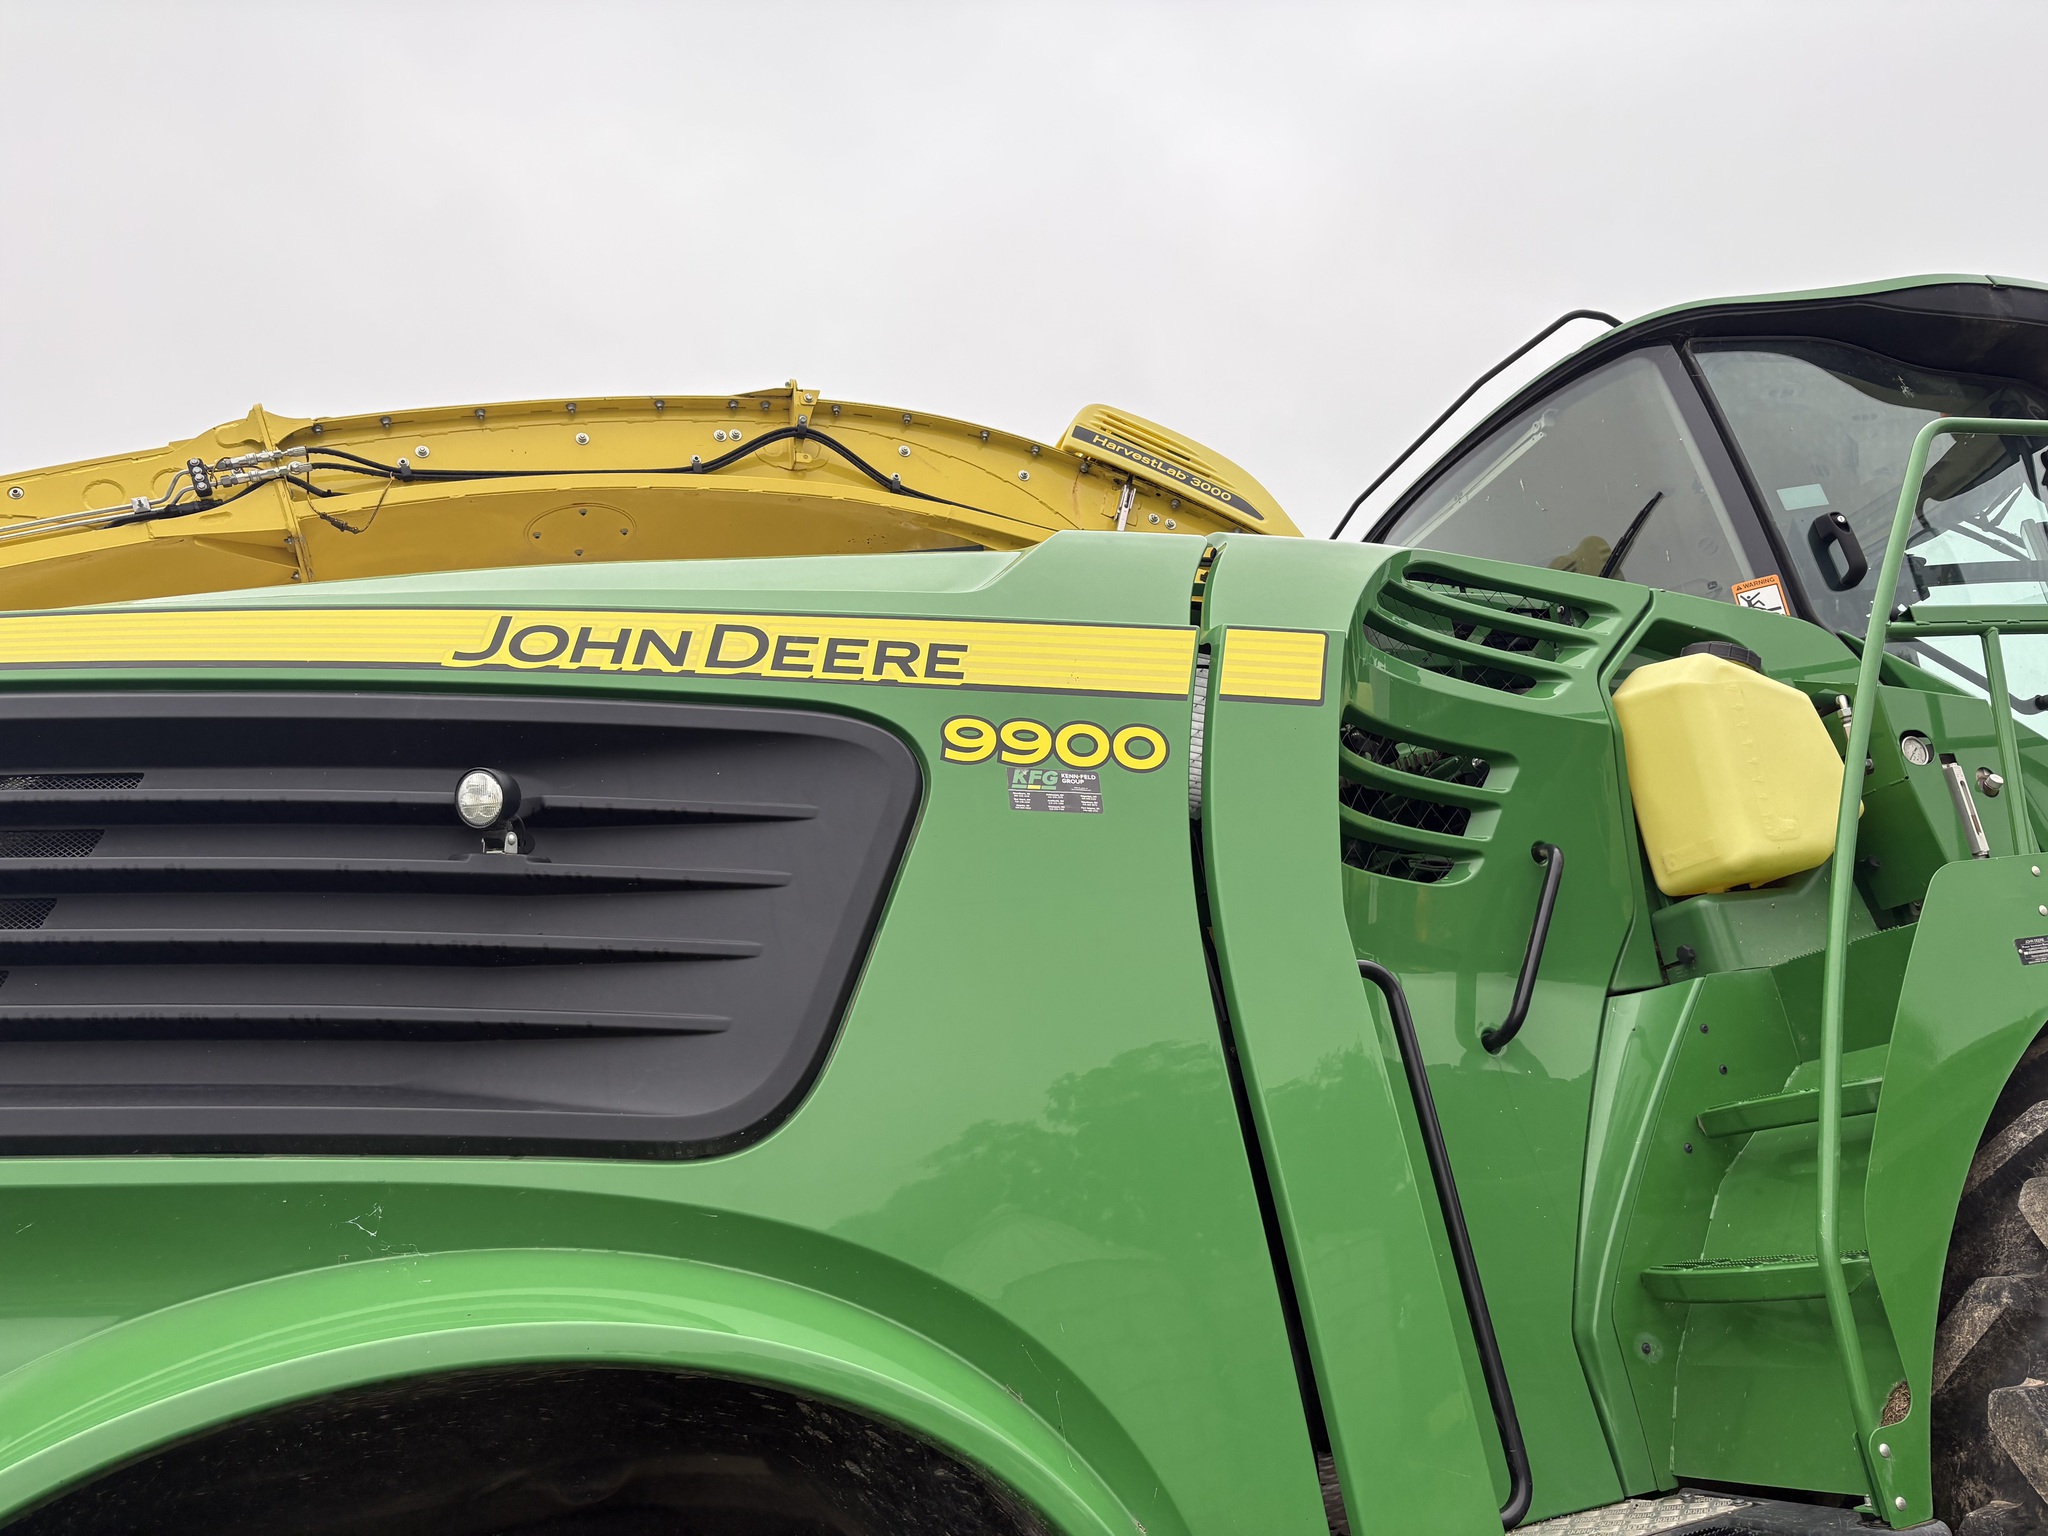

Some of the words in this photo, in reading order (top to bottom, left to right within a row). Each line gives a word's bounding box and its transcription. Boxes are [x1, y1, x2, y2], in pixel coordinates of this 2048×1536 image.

[1092, 434, 1187, 480] HarvestLab
[1190, 476, 1232, 502] 3000
[1743, 577, 1775, 588] WARNING
[452, 615, 695, 667] JOHN
[704, 623, 969, 681] DEERE
[941, 715, 1170, 773] 9900
[1012, 769, 1058, 785] KFG
